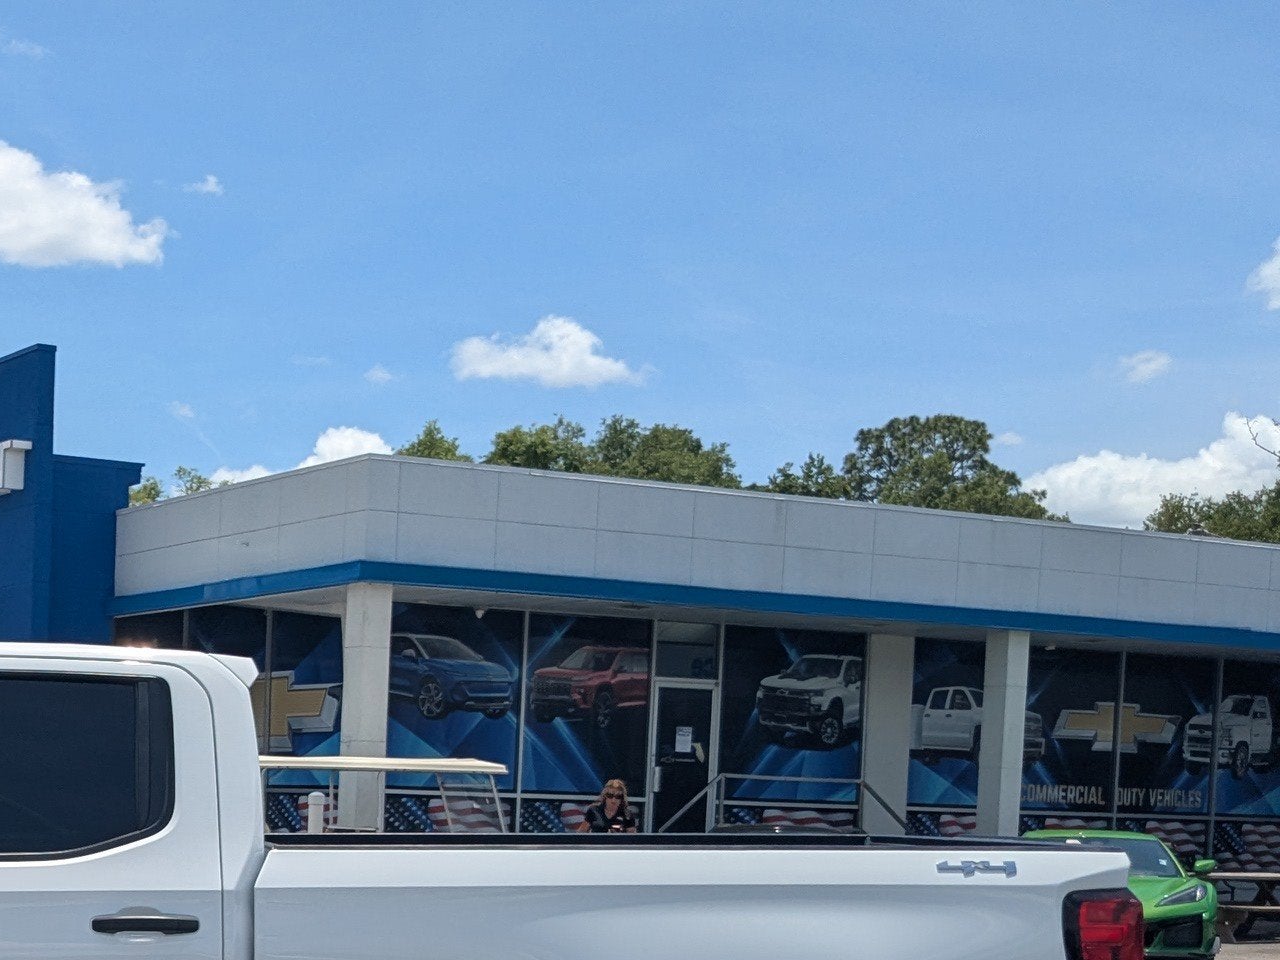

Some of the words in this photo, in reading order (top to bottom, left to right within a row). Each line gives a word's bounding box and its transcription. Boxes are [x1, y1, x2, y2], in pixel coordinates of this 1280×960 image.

[1020, 783, 1106, 805] COMMERCIAL
[1116, 787, 1146, 807] DUTY
[1149, 788, 1202, 809] VEHICLES
